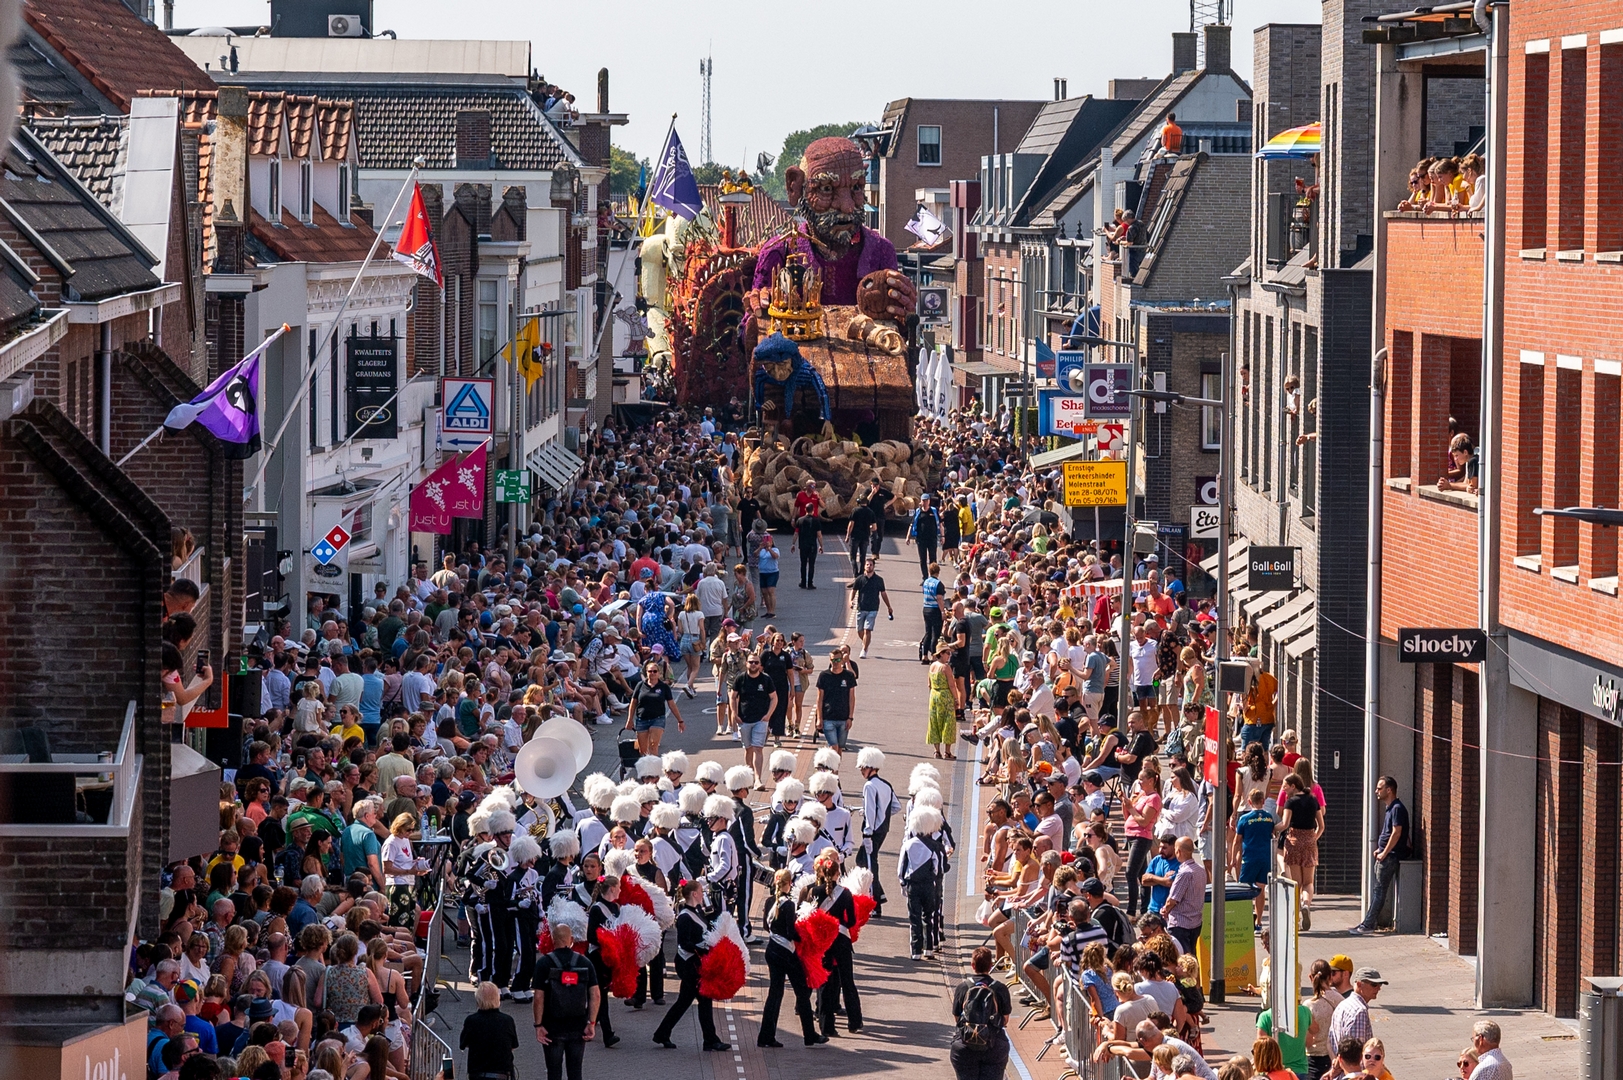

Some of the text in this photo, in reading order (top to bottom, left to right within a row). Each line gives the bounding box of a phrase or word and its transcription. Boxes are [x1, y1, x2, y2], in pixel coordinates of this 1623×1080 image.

[450, 418, 485, 428] ALDI
[1068, 464, 1094, 473] Ernstige
[412, 513, 449, 527] just U
[1403, 634, 1477, 658] shoeby
[1592, 674, 1619, 721] shoeby
